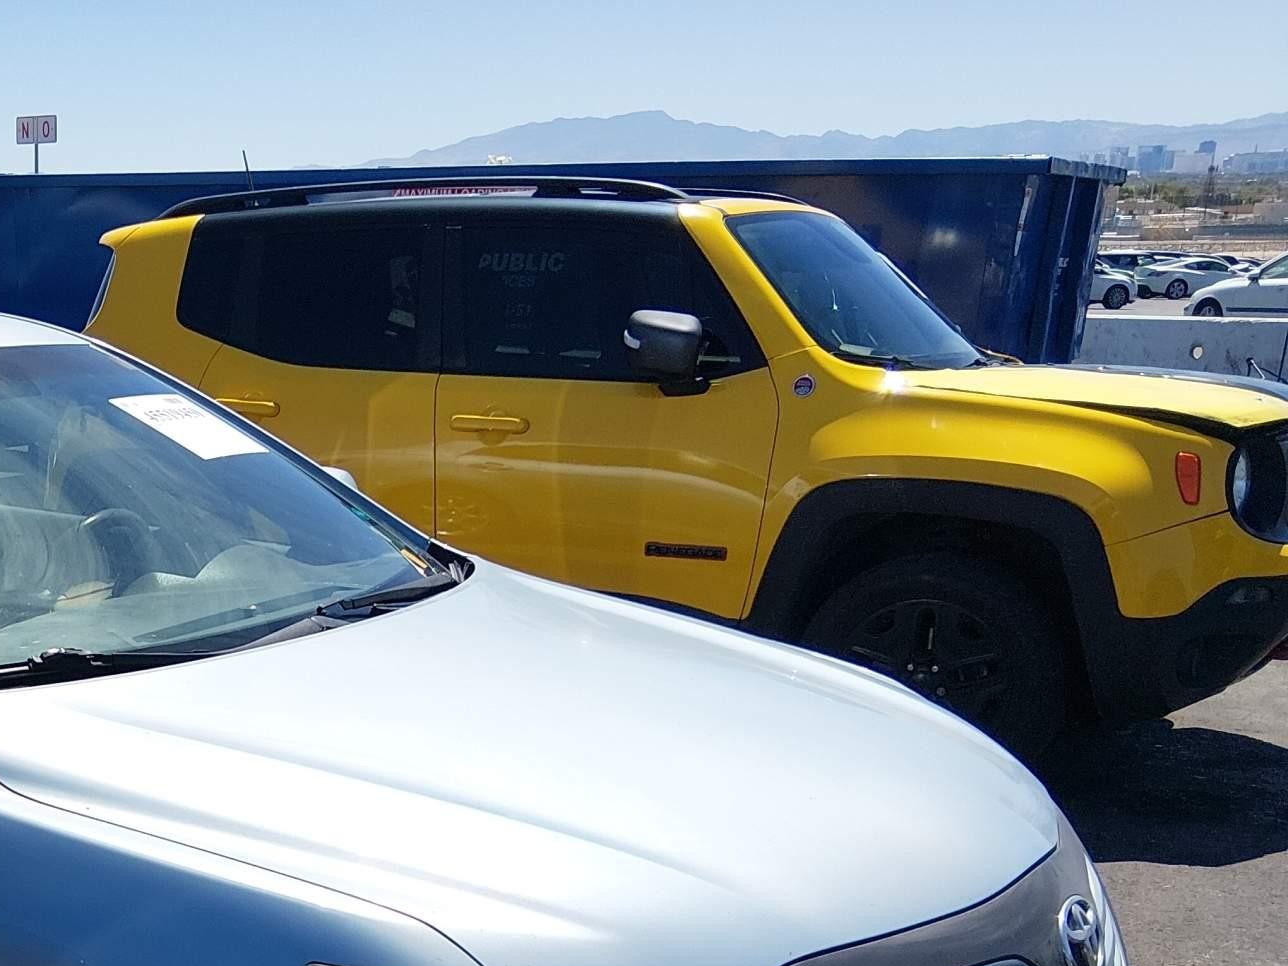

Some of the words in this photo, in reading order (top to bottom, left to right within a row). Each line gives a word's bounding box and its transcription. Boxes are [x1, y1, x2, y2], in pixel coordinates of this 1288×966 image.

[21, 121, 30, 139] N
[42, 120, 50, 138] O
[478, 252, 566, 272] PUBLIC
